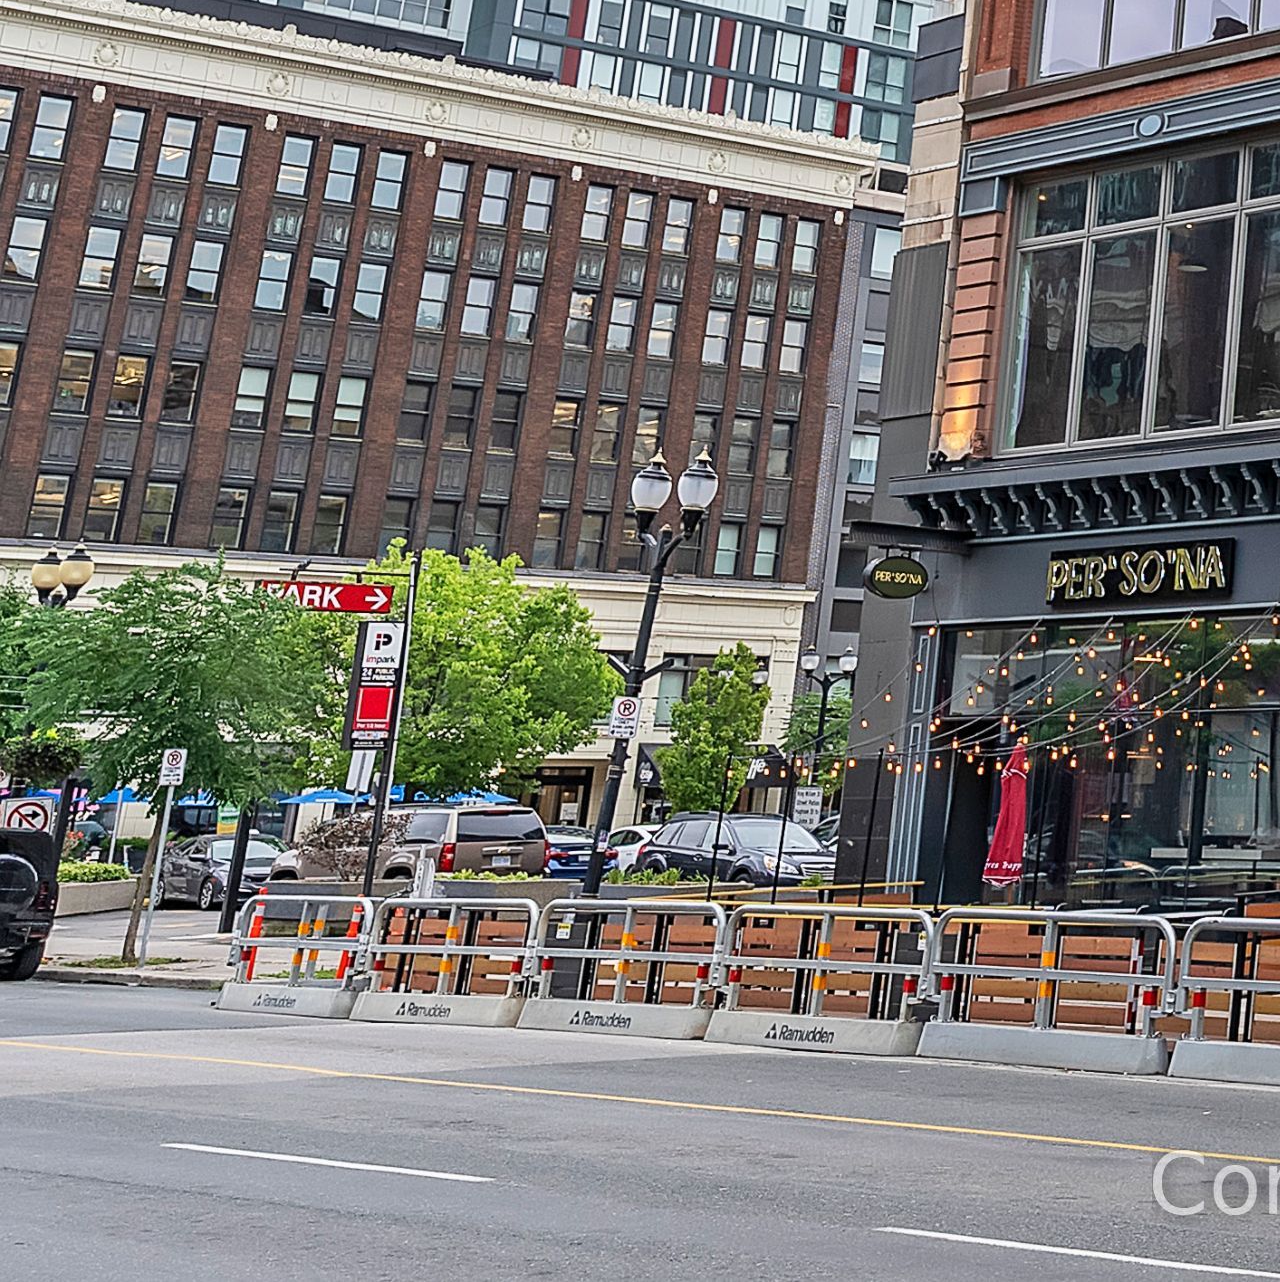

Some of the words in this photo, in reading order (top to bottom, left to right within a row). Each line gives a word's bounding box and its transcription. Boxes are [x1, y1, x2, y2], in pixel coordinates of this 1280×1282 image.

[366, 654, 396, 665] impark
[407, 1004, 451, 1018] Ramudden
[581, 1011, 632, 1029] Ramudden
[779, 1024, 835, 1044] Ramudden
